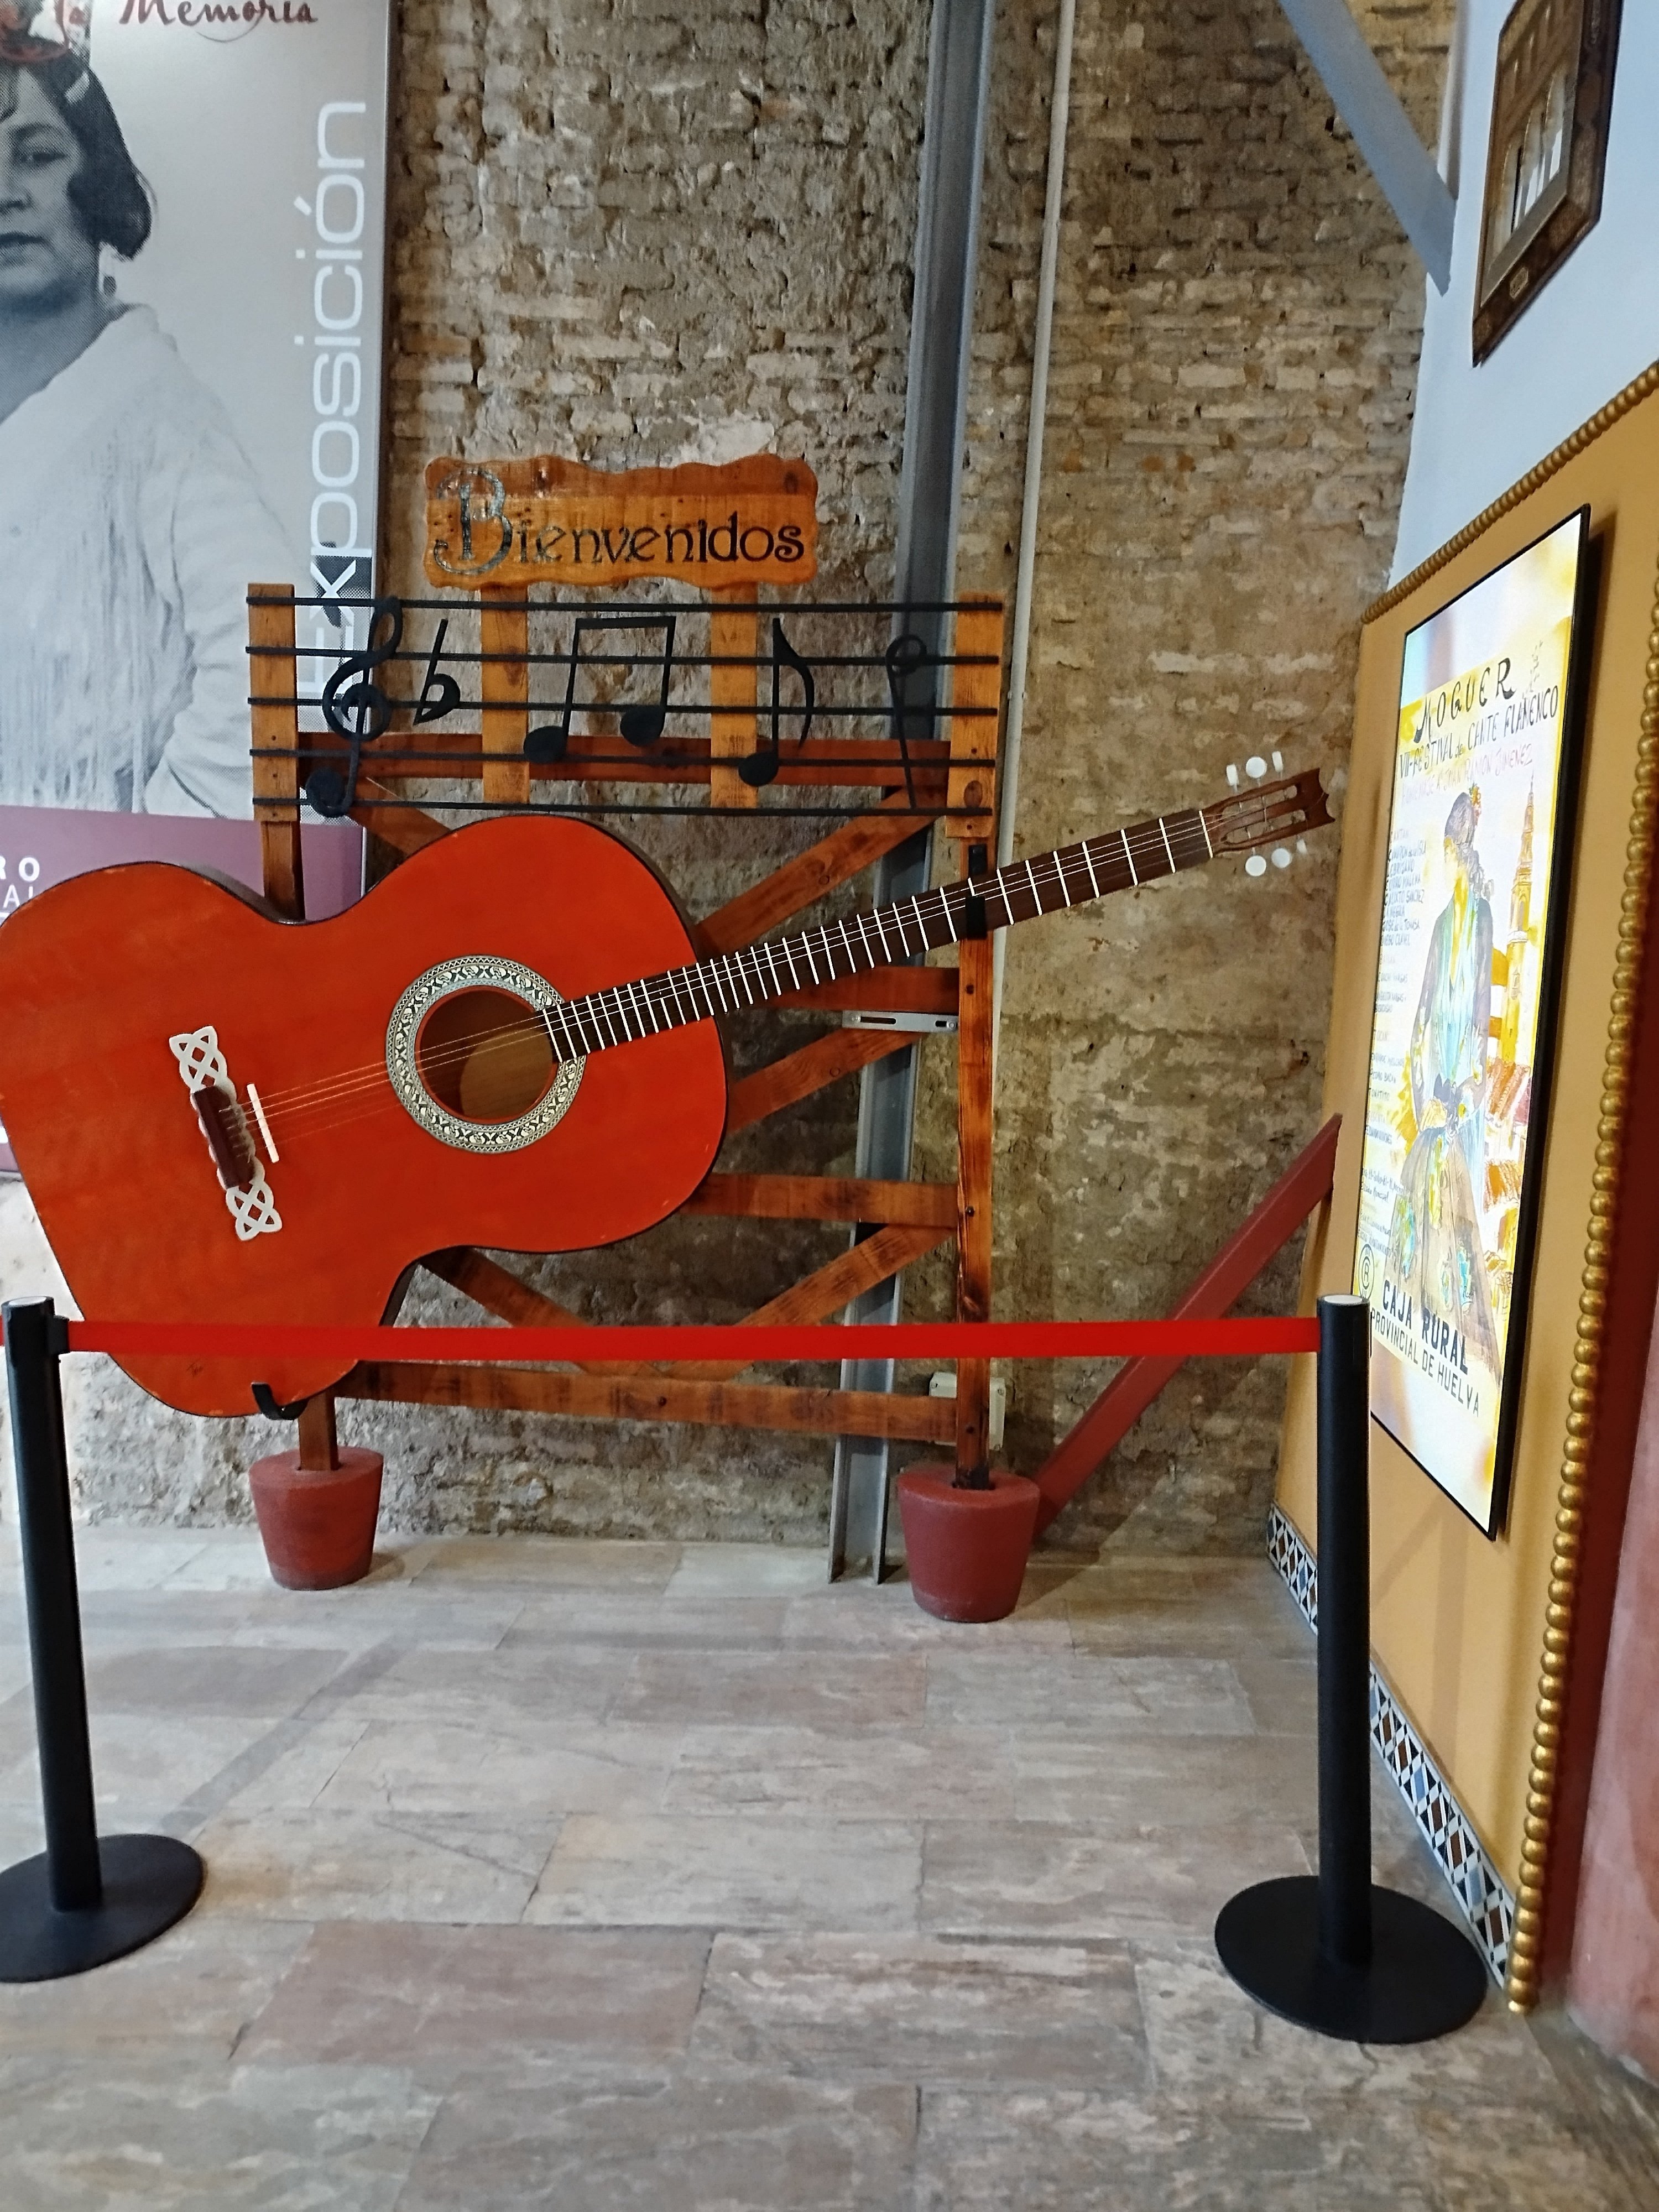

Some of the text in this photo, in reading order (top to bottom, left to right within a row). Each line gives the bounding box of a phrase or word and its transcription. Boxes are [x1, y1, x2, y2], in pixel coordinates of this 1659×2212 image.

[119, 0, 319, 27] Memoria
[434, 467, 805, 575] Bienvenidos
[1413, 658, 1517, 743] MOGUER
[1455, 738, 1463, 758] de
[1468, 712, 1499, 750] CANTE
[1504, 685, 1558, 738] FLAMENCO
[1371, 1307, 1479, 1417] PROVINCIAL DE HUELVA
[1383, 1280, 1468, 1375] CAJA RURAL
